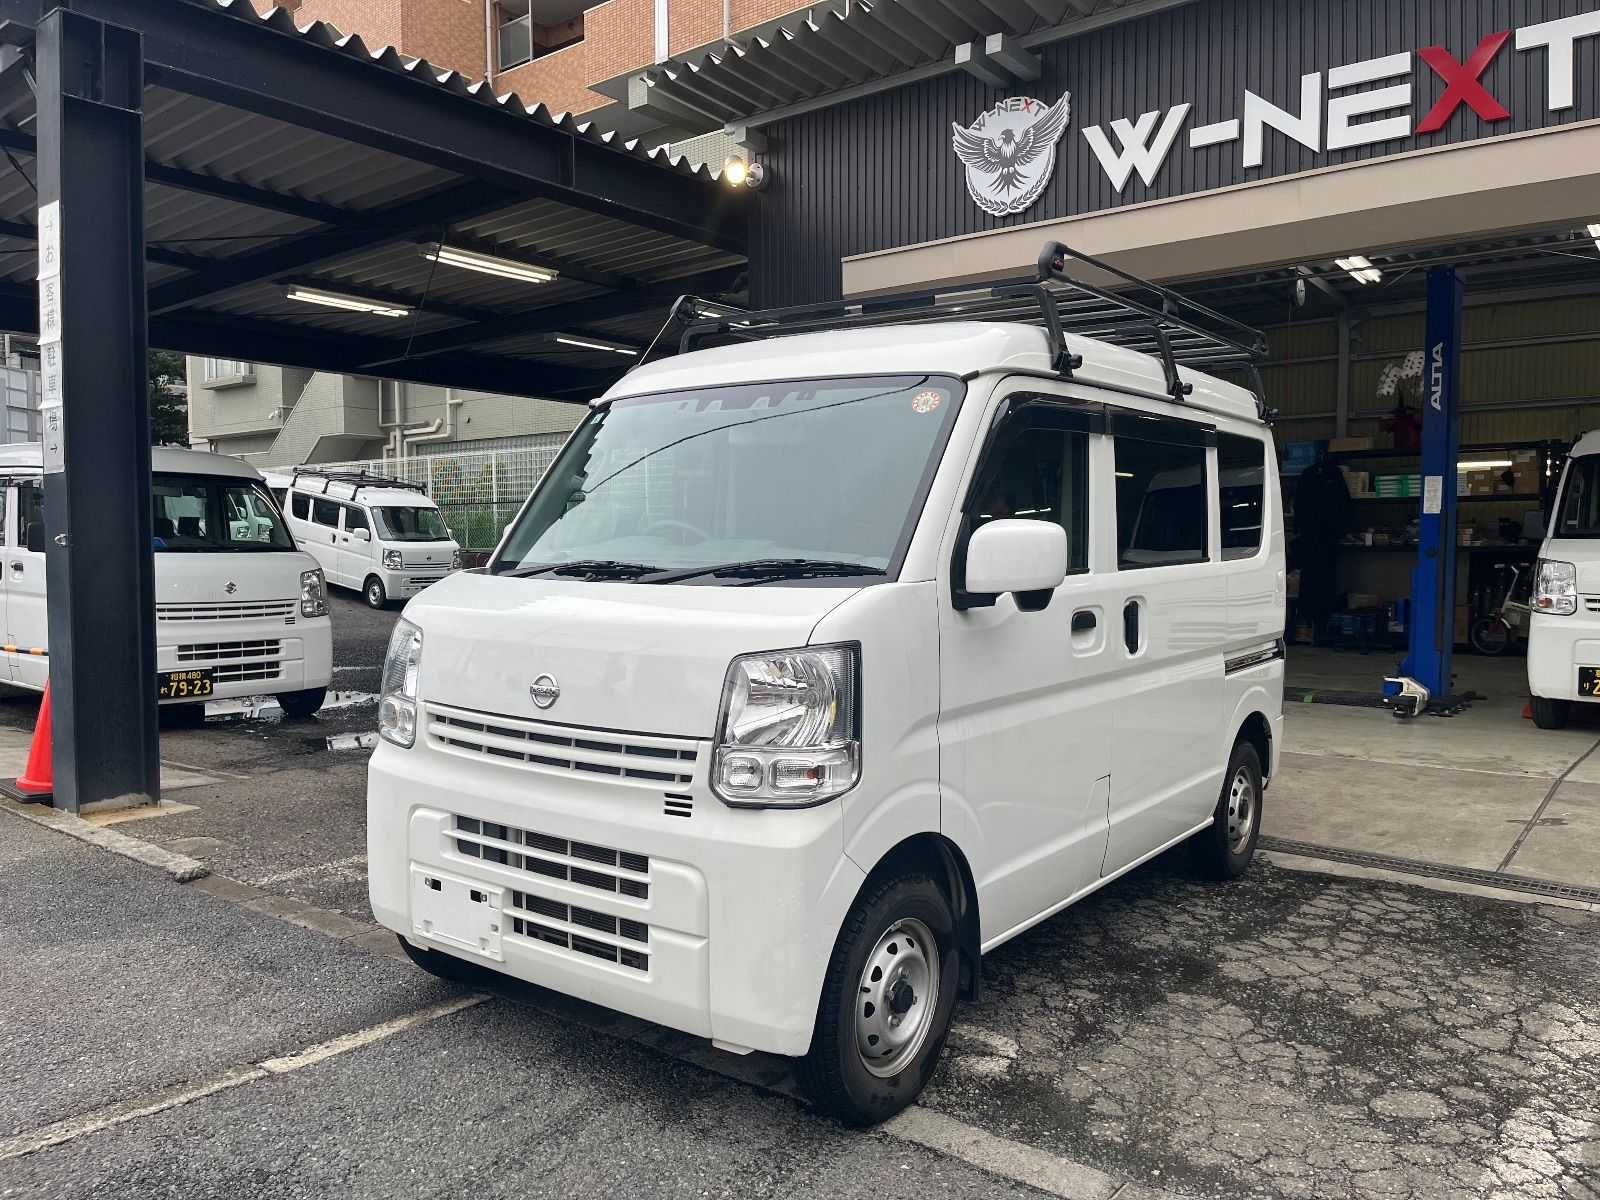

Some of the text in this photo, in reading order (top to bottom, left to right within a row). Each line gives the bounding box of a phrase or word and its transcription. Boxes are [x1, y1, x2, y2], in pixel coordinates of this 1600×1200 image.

[971, 98, 1046, 131] W-NEXT
[1081, 11, 1600, 194] W-NEXT
[169, 679, 211, 697] 79-23
